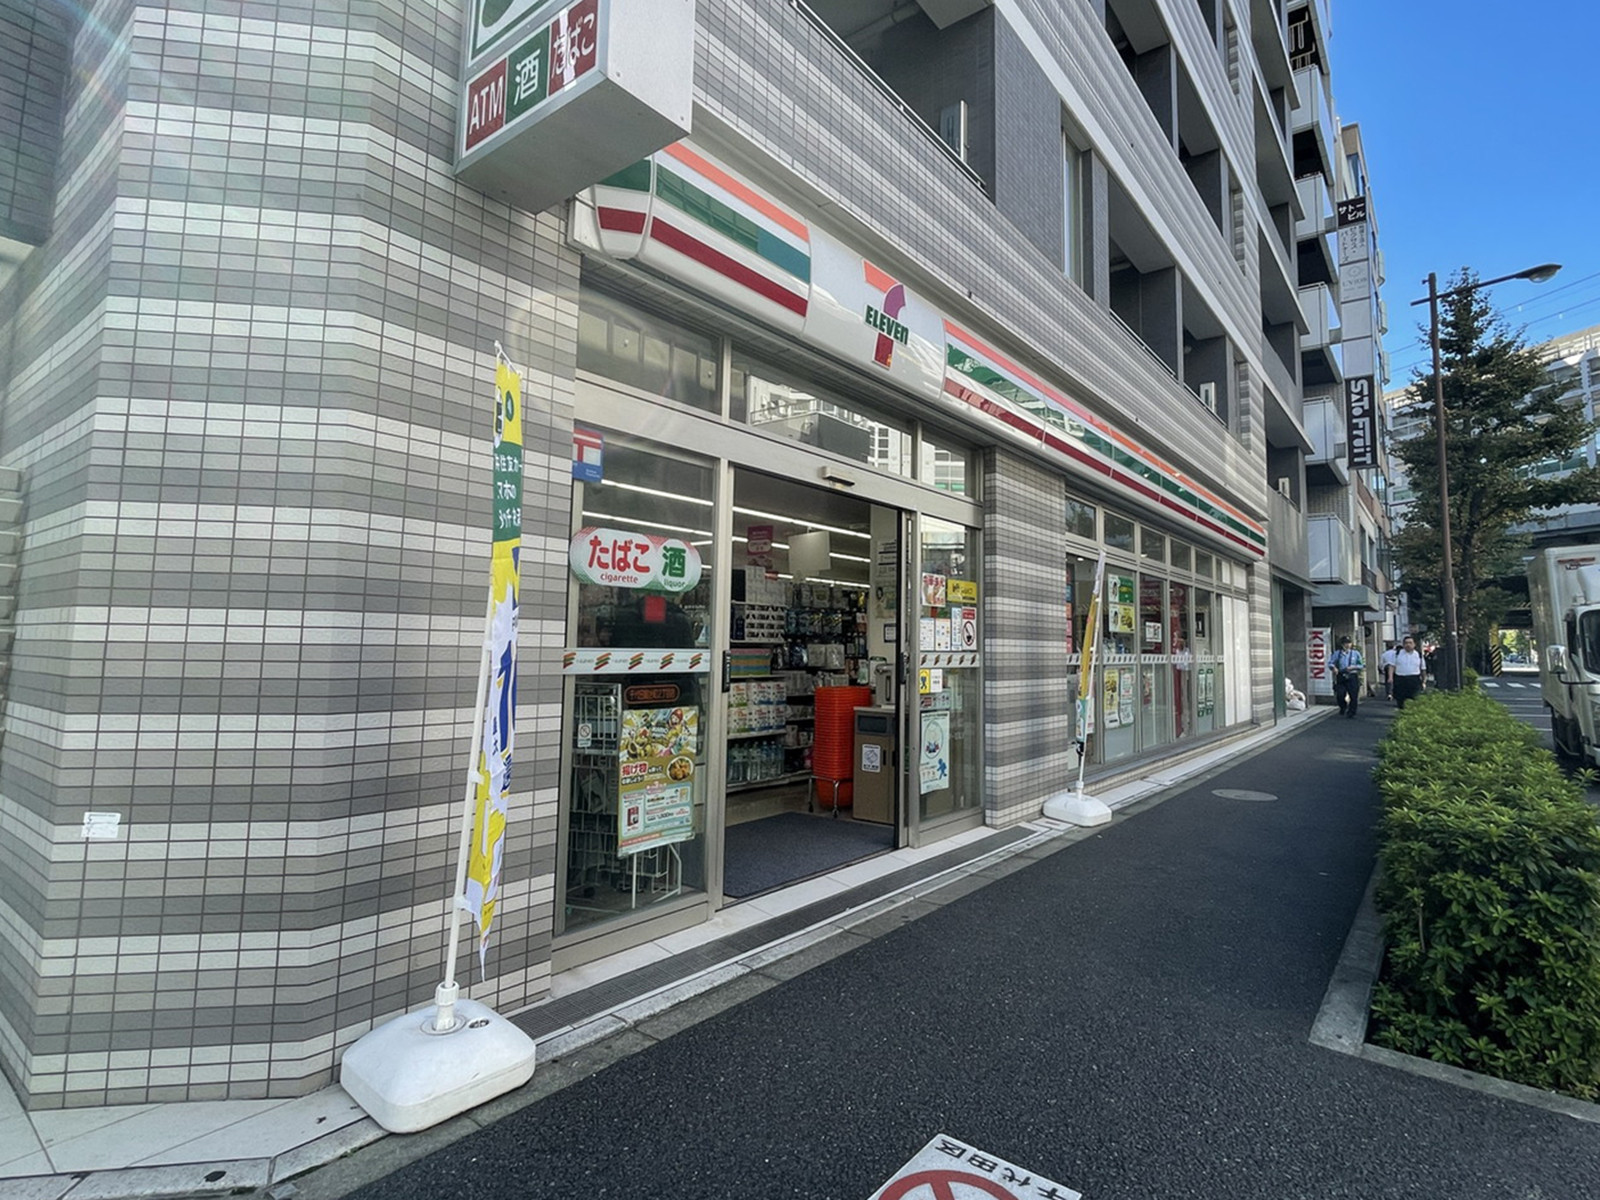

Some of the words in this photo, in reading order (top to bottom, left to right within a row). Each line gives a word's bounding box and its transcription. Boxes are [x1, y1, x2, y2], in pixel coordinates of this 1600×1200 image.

[469, 75, 505, 135] ATM
[513, 48, 542, 105] 酒
[551, 12, 595, 79] たばこ
[1338, 203, 1365, 215] サトー
[1347, 210, 1366, 222] ビル
[588, 535, 650, 573] たばこ
[662, 545, 687, 578] 酒
[600, 573, 639, 584] cigarette
[664, 578, 686, 588] liquor
[1309, 630, 1325, 680] KIRIN
